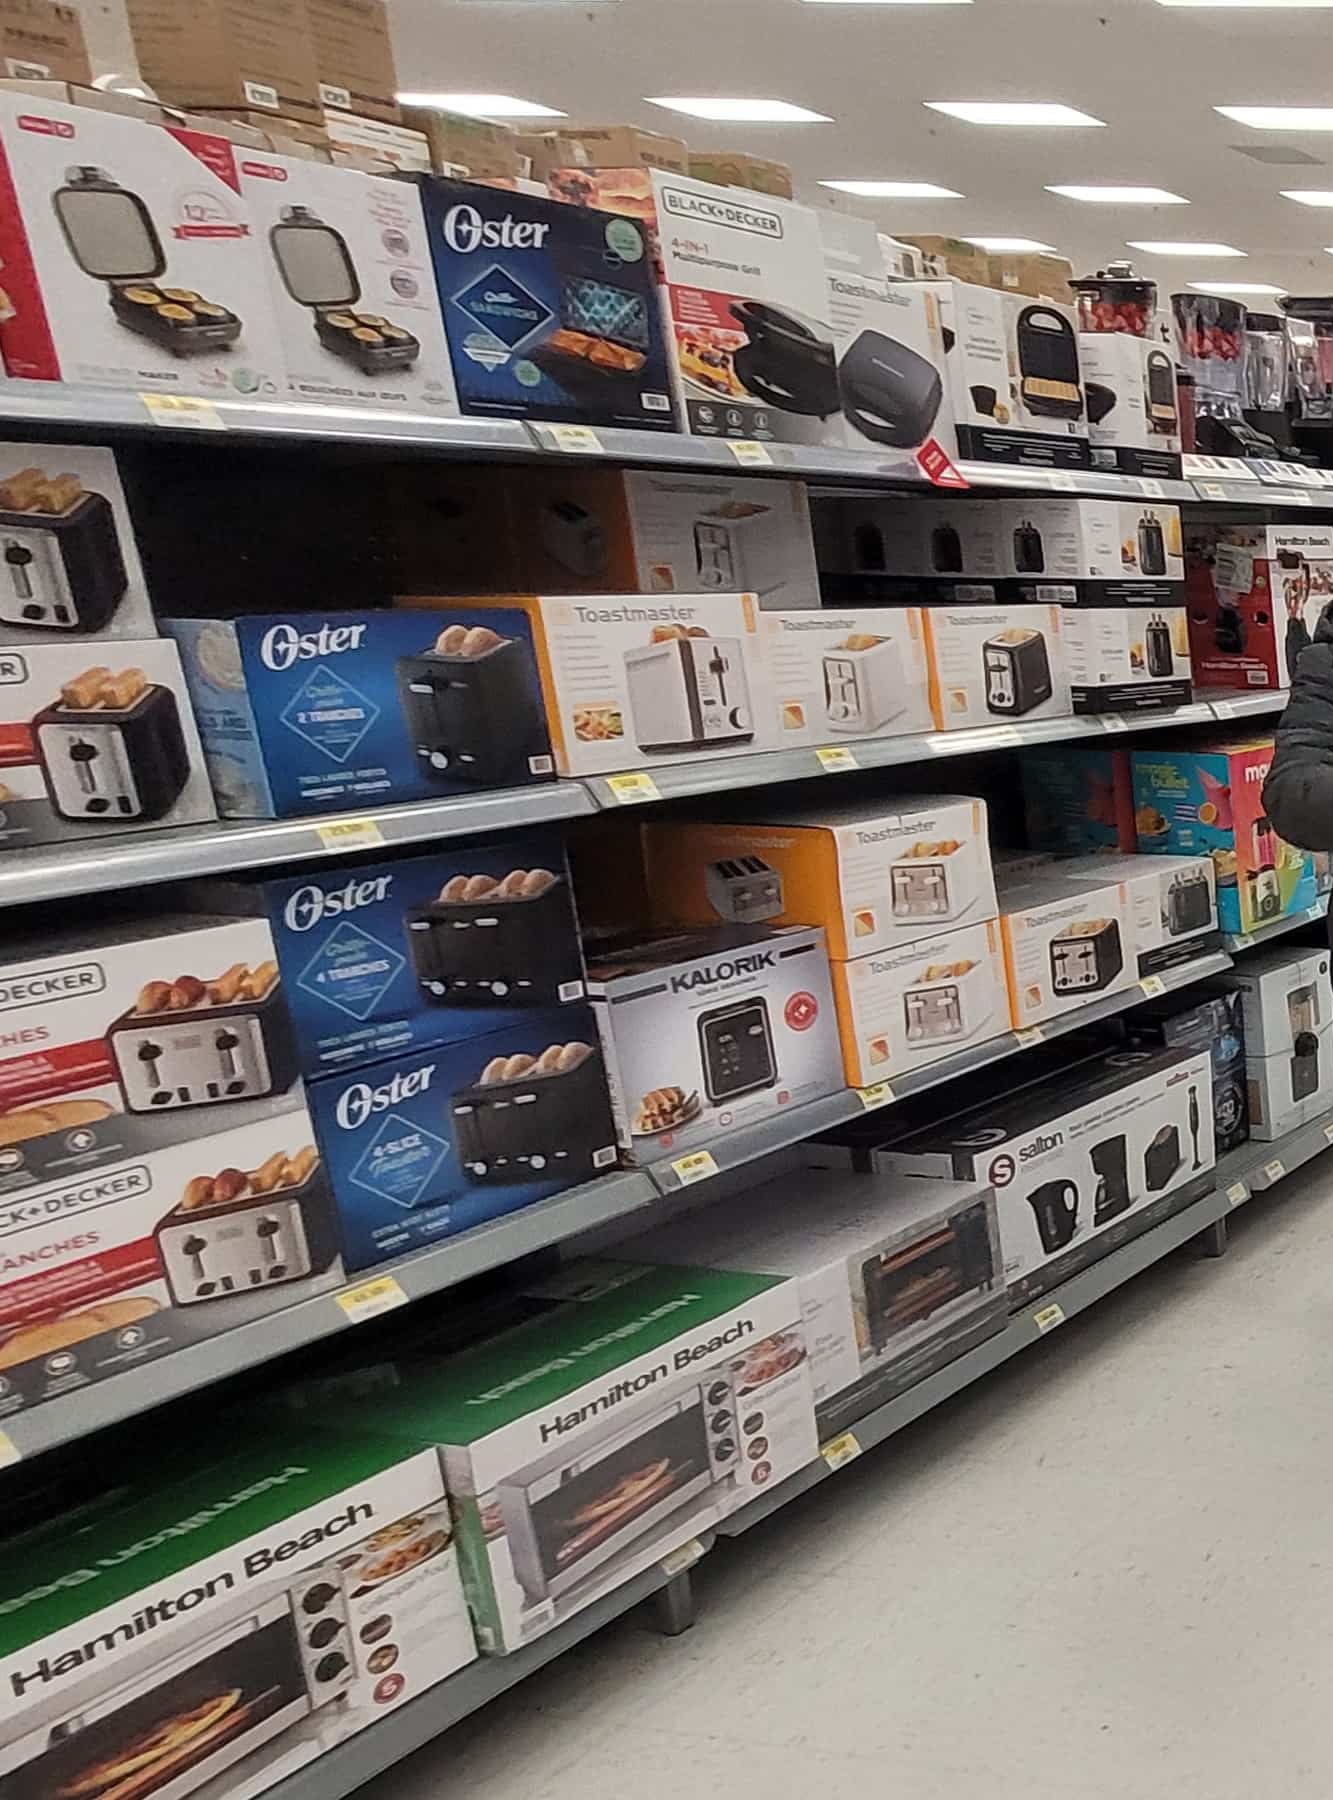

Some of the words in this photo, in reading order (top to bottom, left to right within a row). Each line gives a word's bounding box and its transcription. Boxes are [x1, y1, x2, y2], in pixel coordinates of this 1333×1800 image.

[443, 204, 550, 253] Oster
[667, 193, 778, 233] BLACK+DECKER
[1274, 535, 1306, 546] Hamilton
[1308, 536, 1330, 546] Beach
[574, 605, 696, 624] Toastmaster
[780, 618, 856, 632] Toastmaster
[947, 613, 1009, 627] Toastmaster
[260, 623, 367, 671] Oster
[856, 820, 937, 845] Toastmaster
[284, 874, 393, 932] Oster
[670, 950, 777, 996] KALORIK
[335, 1063, 438, 1130] Oster
[1018, 1131, 1065, 1163] salton
[538, 1361, 670, 1444] Hamilton
[673, 1317, 756, 1371] Beach
[8, 1568, 235, 1699] Hamilton
[243, 1500, 375, 1579] Beach
